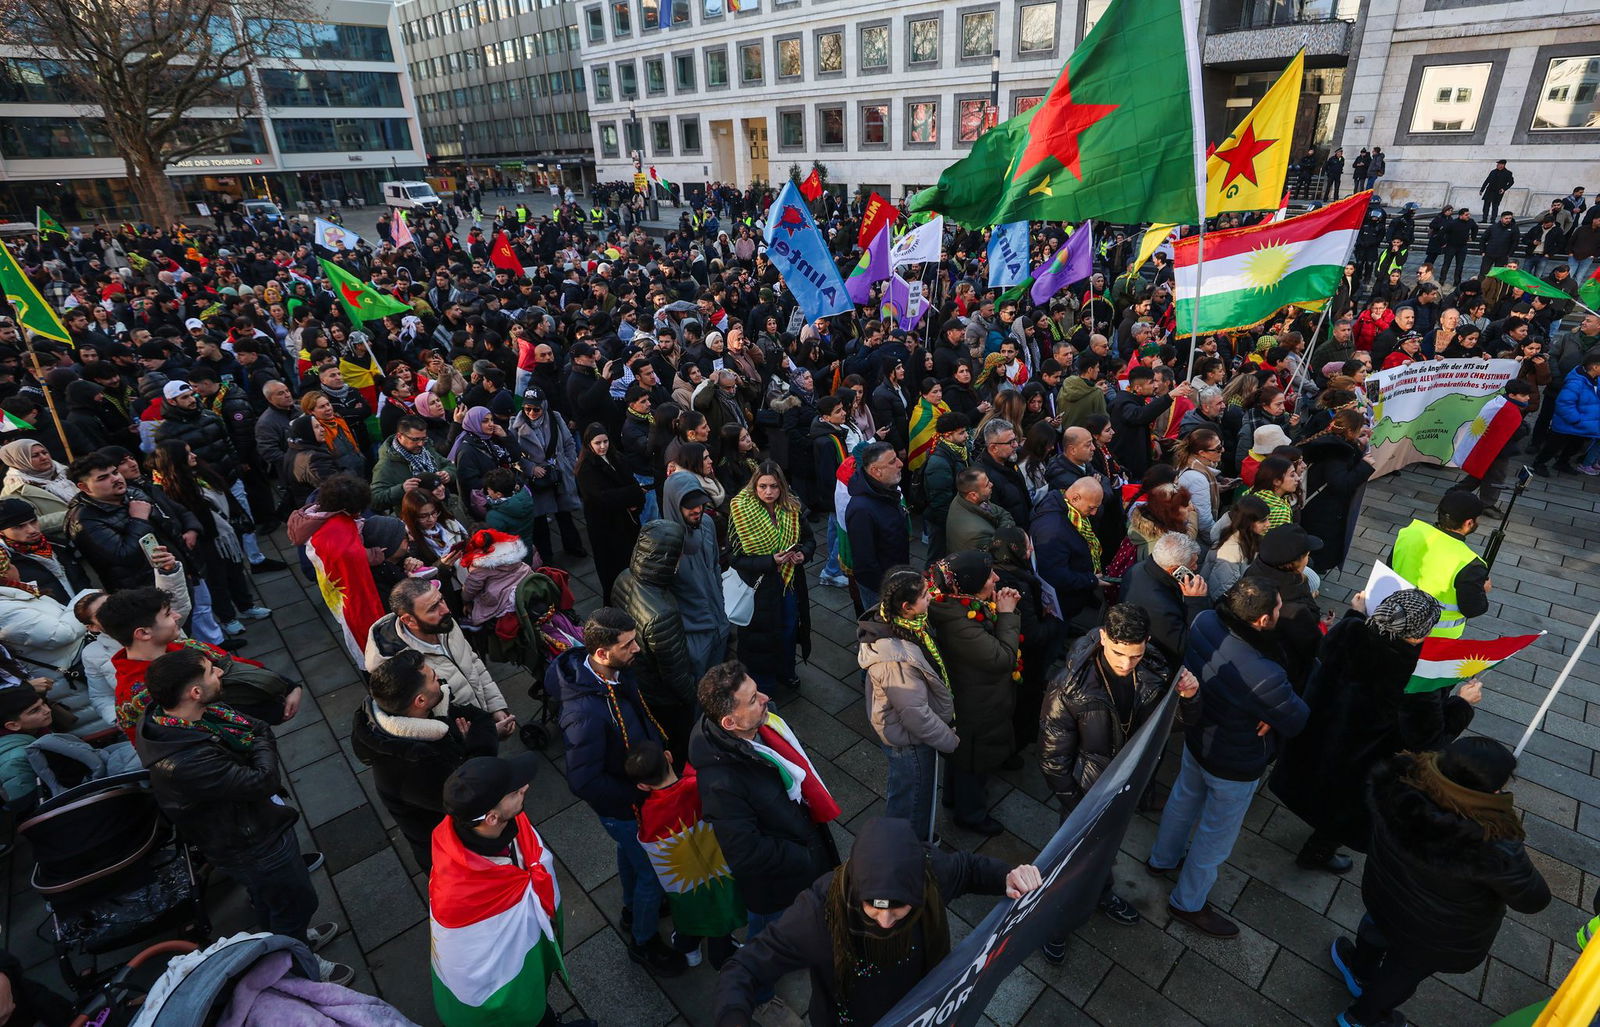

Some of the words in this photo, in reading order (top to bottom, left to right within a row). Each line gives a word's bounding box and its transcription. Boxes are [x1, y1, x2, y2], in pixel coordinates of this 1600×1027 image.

[194, 159, 210, 167] DES
[211, 158, 253, 167] TOURISMUS
[1470, 372, 1511, 380] CHRISTINNEN
